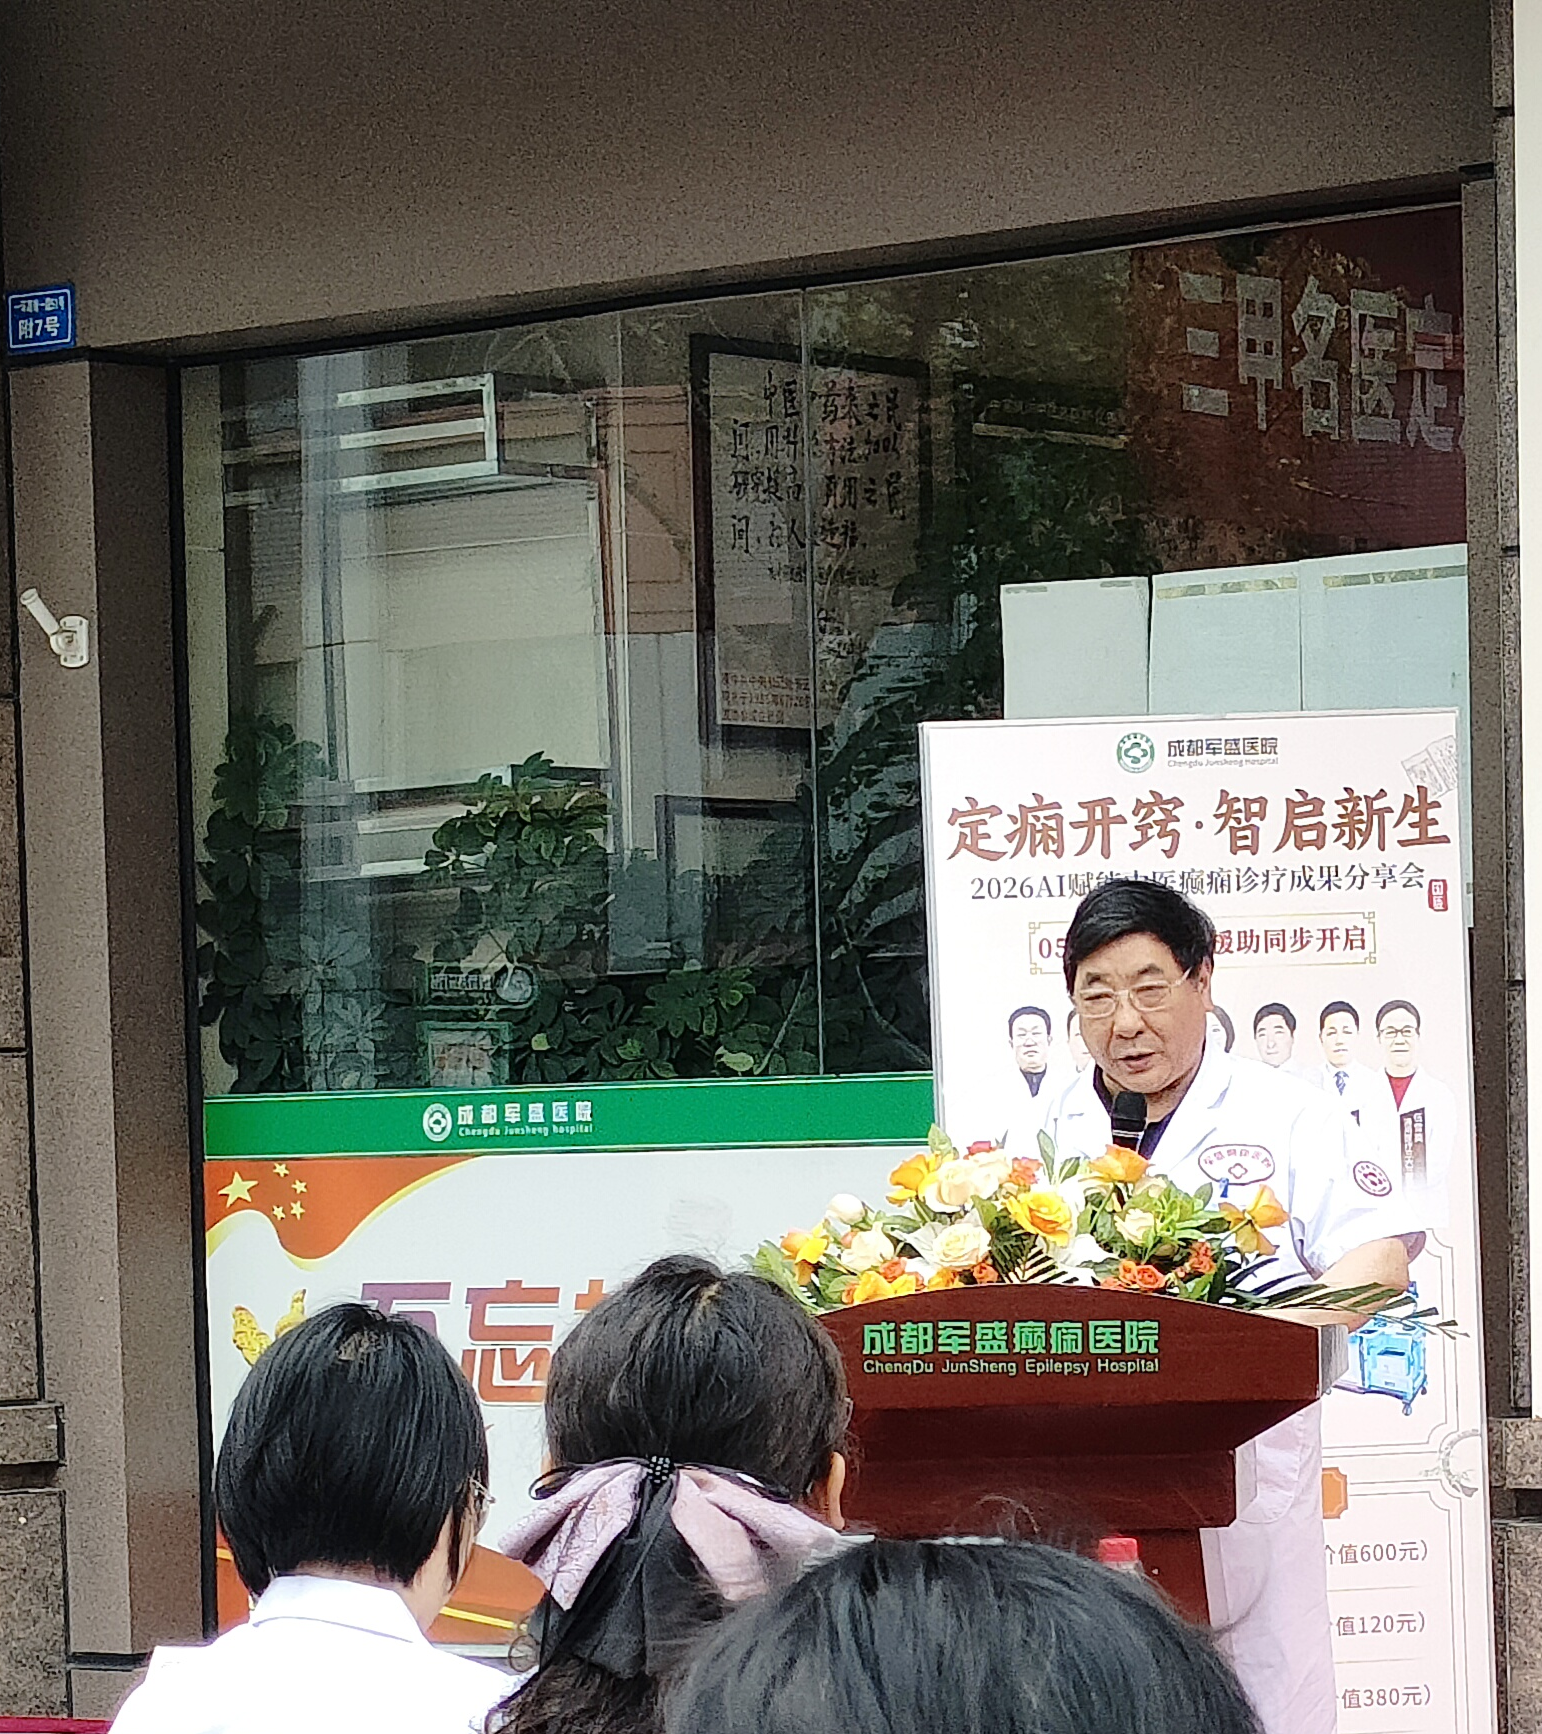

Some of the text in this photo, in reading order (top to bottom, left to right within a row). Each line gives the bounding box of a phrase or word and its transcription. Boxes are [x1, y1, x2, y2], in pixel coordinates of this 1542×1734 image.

[19, 316, 60, 340] 附7号
[1179, 273, 1462, 454] 三甲名医定
[1168, 737, 1278, 757] 成都军盛医院
[947, 786, 1451, 861] 定痫开窍·智启新生
[458, 1101, 592, 1124] 成都军盛医院
[862, 1320, 1159, 1355] 成都军盛癫痫医院
[941, 1359, 1017, 1376] JunSheng
[1025, 1358, 1090, 1376] Epilepsy
[1097, 1358, 1159, 1374] Hospital
[1330, 1611, 1426, 1636] 值120元）
[1336, 1684, 1431, 1709] 值380元）
